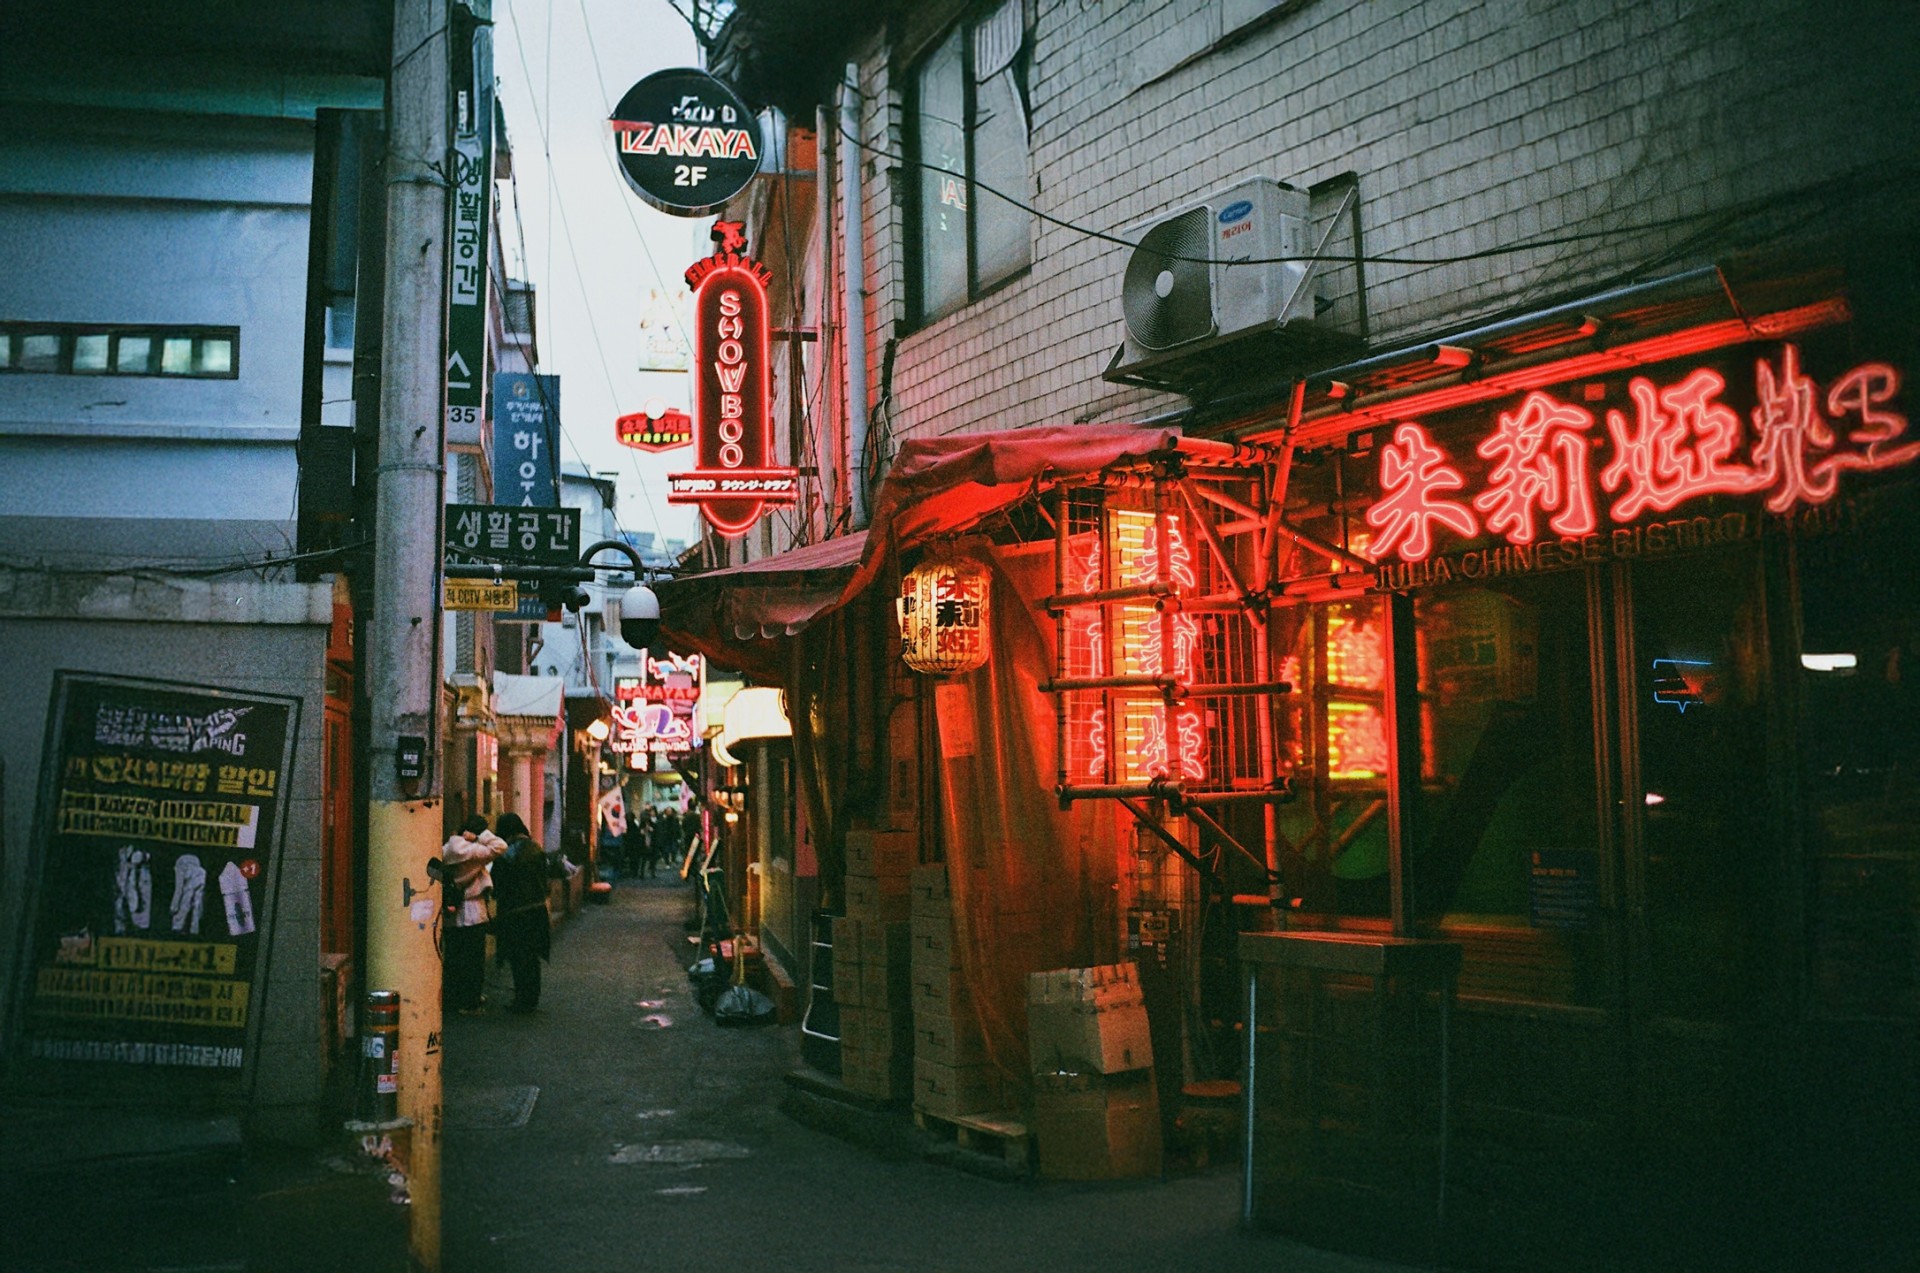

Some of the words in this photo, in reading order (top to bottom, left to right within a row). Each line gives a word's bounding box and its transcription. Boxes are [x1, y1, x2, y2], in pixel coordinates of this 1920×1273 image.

[621, 123, 757, 160] IZAKAYA
[673, 164, 708, 187] 2F
[685, 253, 774, 290] FIREBALL
[714, 290, 748, 469] SHOWBOO
[446, 407, 476, 424] 35
[456, 511, 572, 551] 생활공간
[1373, 556, 1452, 592] JULIA
[1460, 532, 1603, 580] CHINESE
[1610, 512, 1748, 555] BISTRO
[458, 588, 481, 604] CCTV
[485, 588, 511, 606] 작동중
[617, 685, 685, 700] IZAKAYA
